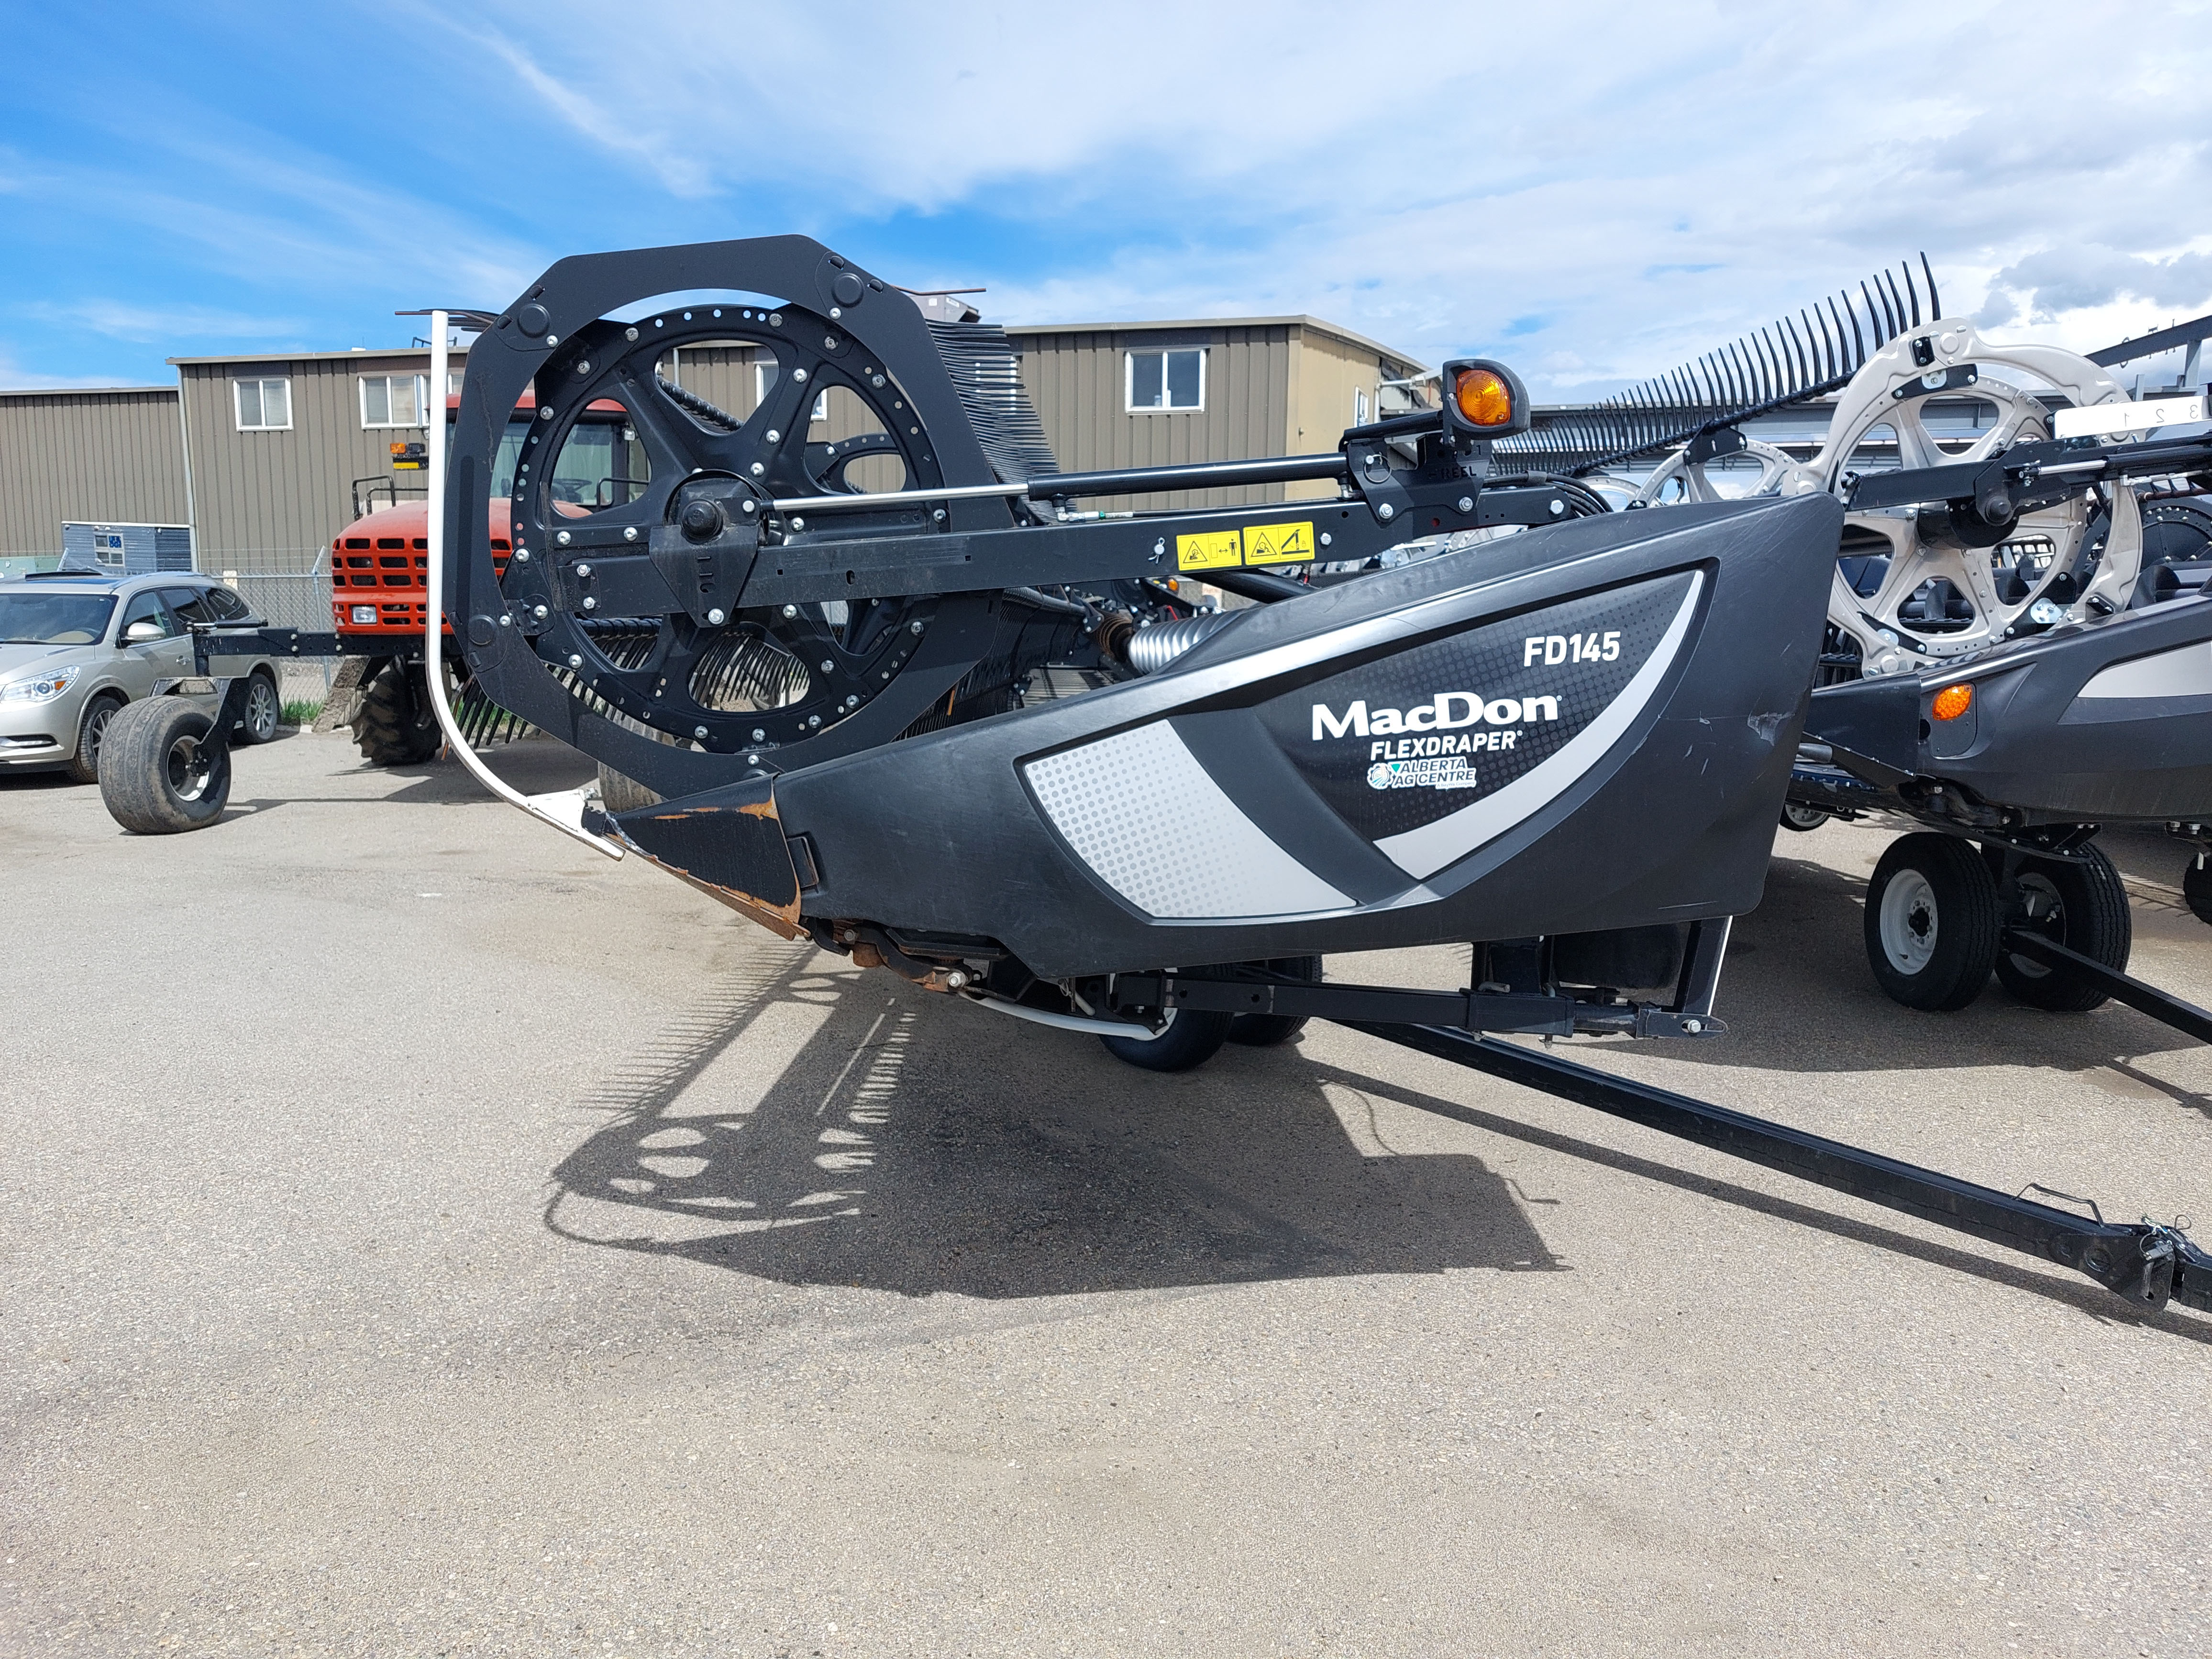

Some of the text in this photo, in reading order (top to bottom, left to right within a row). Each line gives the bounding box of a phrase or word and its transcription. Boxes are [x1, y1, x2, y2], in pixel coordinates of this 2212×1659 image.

[1440, 466, 1477, 479] REEL
[1524, 631, 1621, 667] FD145
[1400, 758, 1466, 773] ALBERTA
[1394, 770, 1474, 786] AG CENTRE
